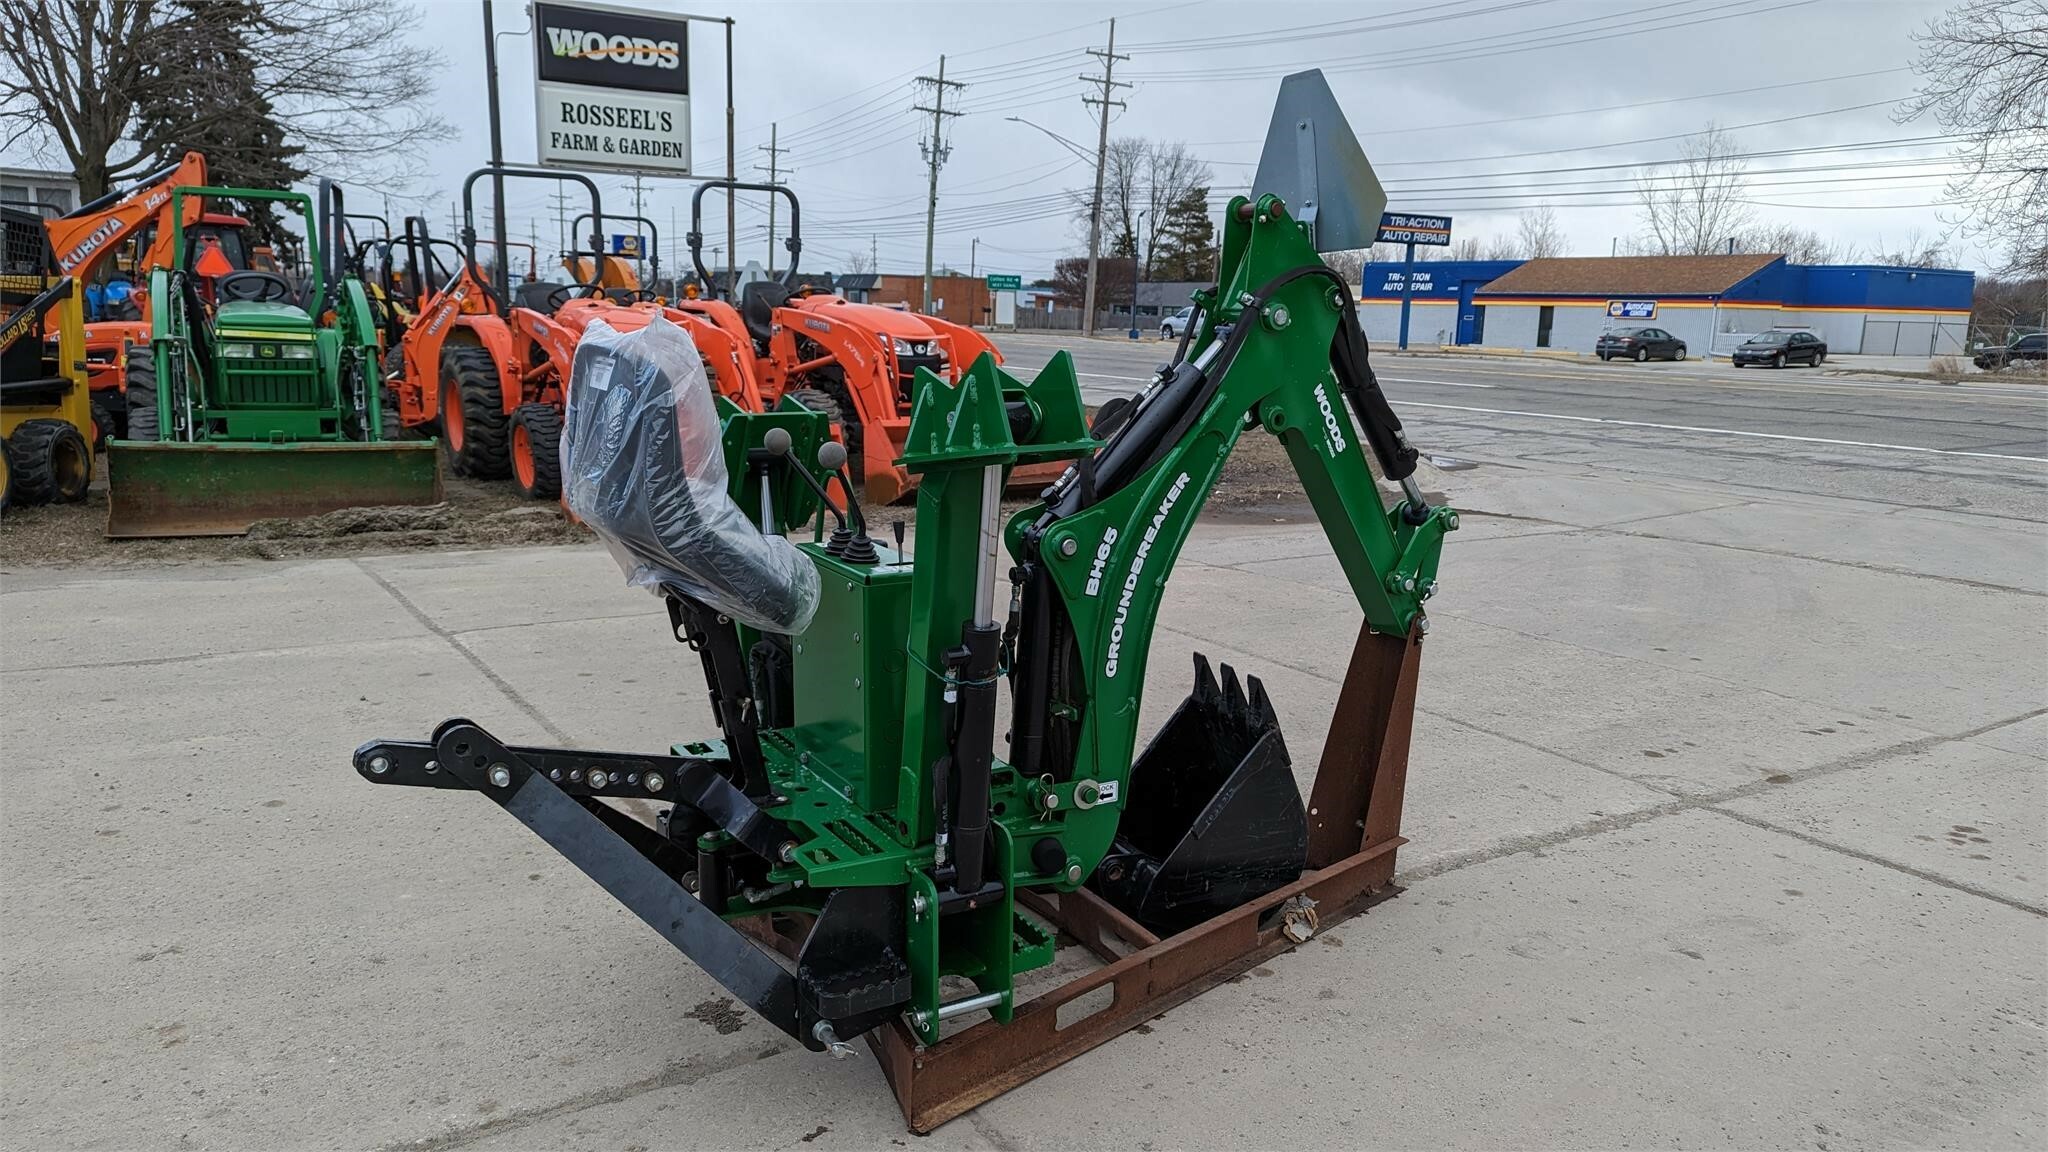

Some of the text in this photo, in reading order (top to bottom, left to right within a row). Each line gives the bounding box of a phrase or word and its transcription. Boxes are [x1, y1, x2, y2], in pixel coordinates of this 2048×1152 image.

[546, 27, 680, 69] WOODS
[560, 102, 673, 132] ROSSEEL'S
[550, 131, 683, 158] FARM & GARDEN
[60, 216, 126, 272] KUBOTA
[1382, 230, 1448, 243] AUTO REPAIR
[1382, 283, 1433, 291] AUTO EPAIR
[1313, 382, 1347, 453] WOODS
[1085, 526, 1119, 597] BH65
[1104, 471, 1191, 679] GROUNDBREAKER
